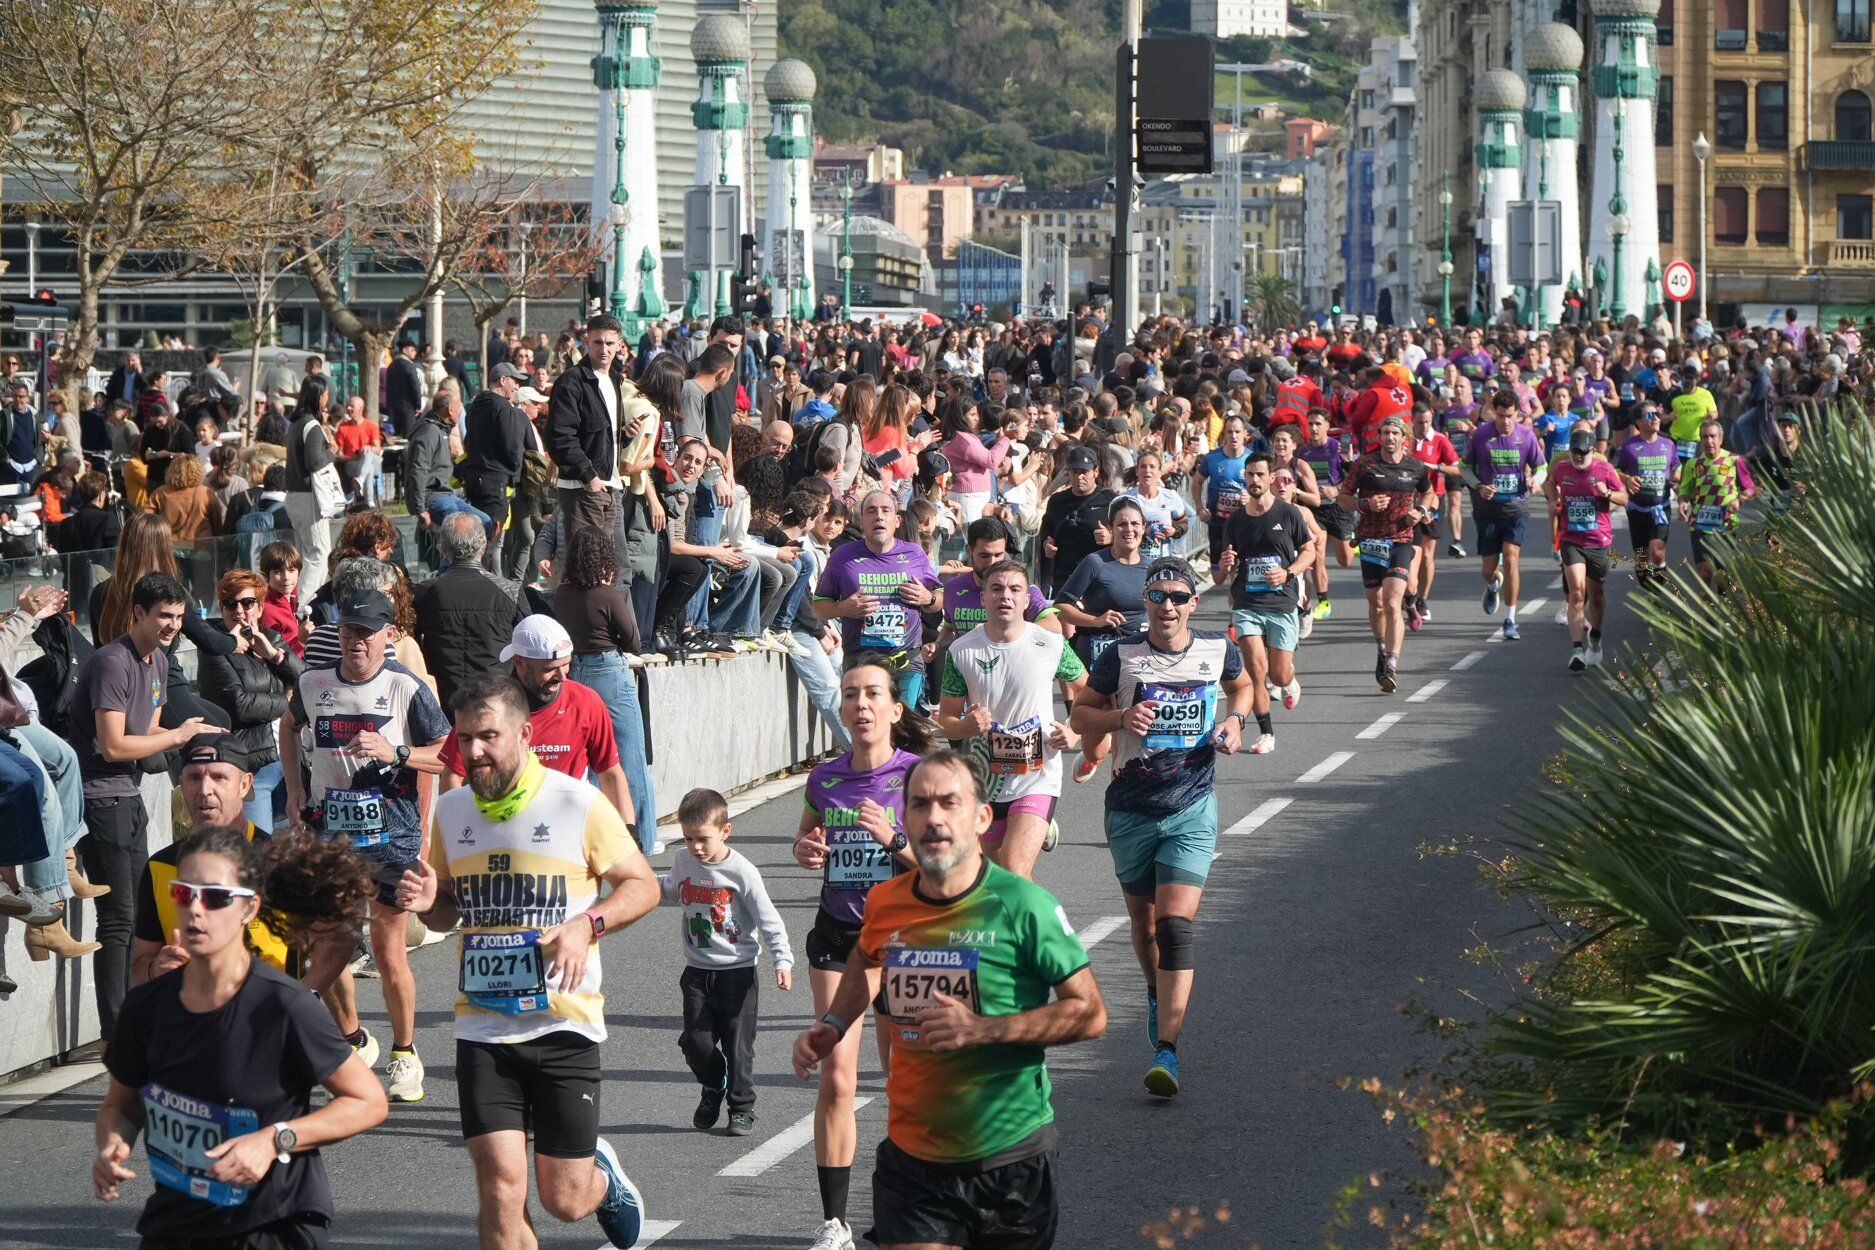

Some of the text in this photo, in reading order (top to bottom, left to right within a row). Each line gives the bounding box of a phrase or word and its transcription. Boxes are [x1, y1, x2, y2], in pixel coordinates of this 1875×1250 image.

[1671, 274, 1688, 287] 40
[1569, 507, 1595, 517] 9556
[858, 571, 909, 585] BEHOBIA
[873, 585, 900, 594] SEBAST
[865, 614, 904, 628] 9472
[318, 720, 330, 731] 58
[1166, 722, 1201, 730] ANTONIO
[994, 731, 1038, 750] 12945
[328, 802, 379, 821] 9188
[843, 830, 874, 843] Jom
[487, 853, 511, 873] 59
[831, 848, 891, 868] 10972
[844, 872, 874, 880] SANDRA
[466, 953, 532, 977] 10271
[487, 980, 512, 989] LLORI
[889, 974, 970, 1000] 15794
[148, 1107, 219, 1152] 11070
